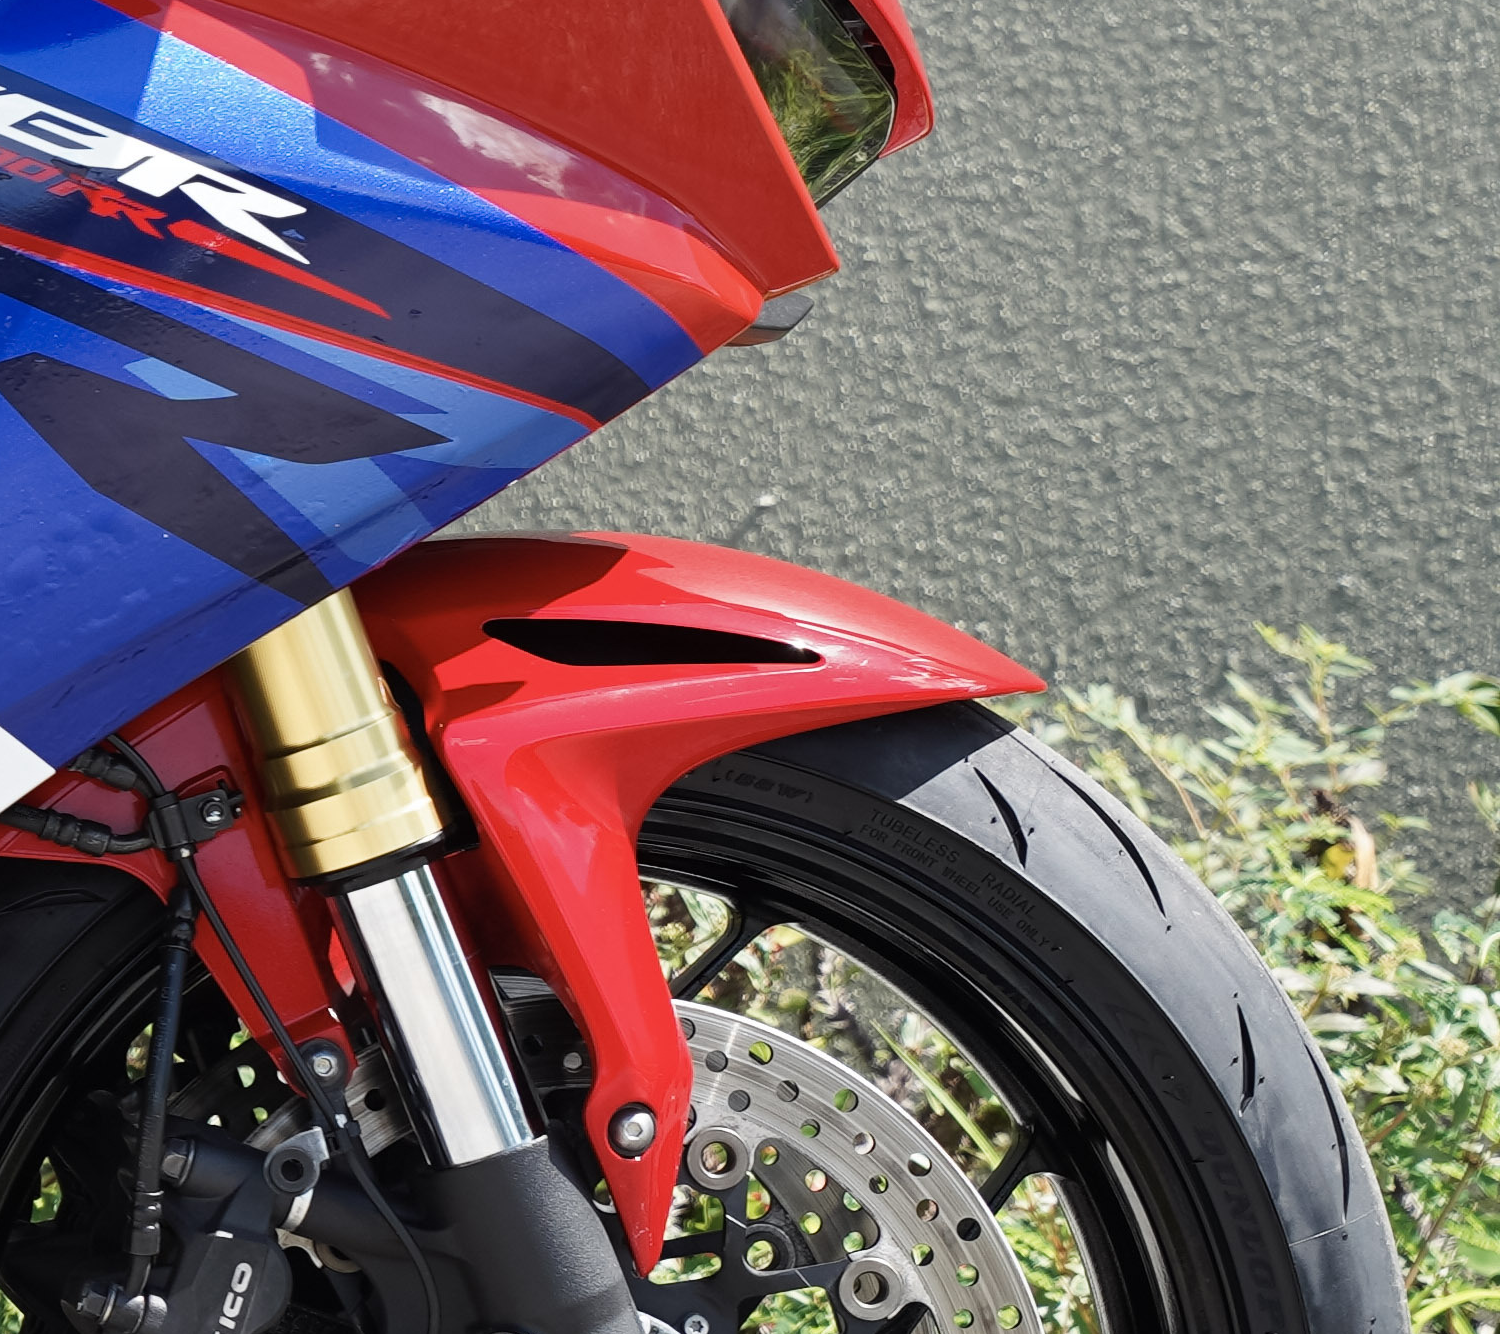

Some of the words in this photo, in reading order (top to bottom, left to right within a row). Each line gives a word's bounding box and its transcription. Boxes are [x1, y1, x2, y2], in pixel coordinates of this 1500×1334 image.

[859, 823, 890, 844] FOR
[892, 837, 937, 869] FRONT
[941, 865, 981, 897] WHEEL
[987, 895, 1016, 920] USE
[1015, 918, 1052, 949] ONLY
[869, 807, 962, 864] TUBELESS
[980, 871, 1039, 920] RADIAL
[1194, 1123, 1286, 1330] DUNLOP
